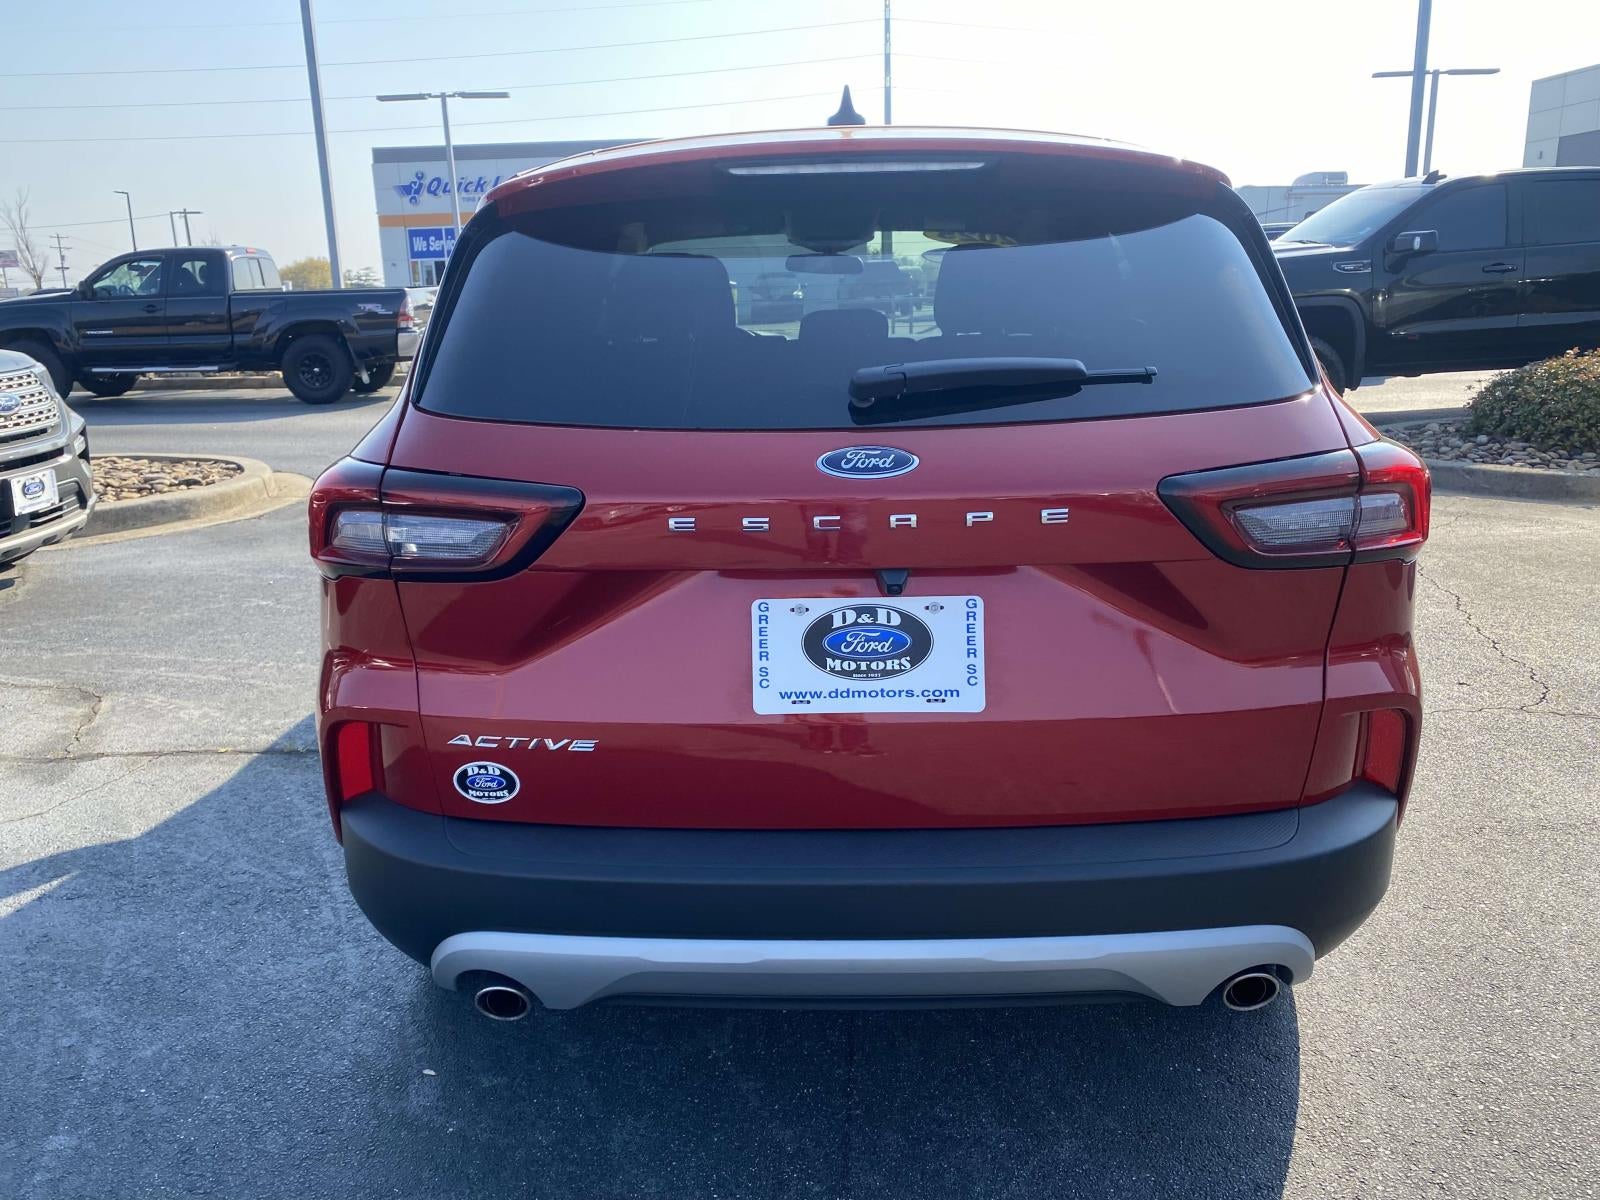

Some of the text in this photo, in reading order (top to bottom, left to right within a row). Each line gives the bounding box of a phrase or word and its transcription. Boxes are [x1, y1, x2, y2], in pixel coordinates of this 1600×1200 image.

[427, 176, 487, 196] Quick
[412, 236, 428, 252] We
[840, 450, 895, 469] Ford
[667, 508, 1070, 533] ESCAPE
[831, 607, 902, 629] D&D
[758, 602, 770, 689] GREER SC
[841, 631, 894, 654] Ford
[965, 598, 978, 687] GREER SC
[826, 656, 912, 672] MOTORS
[779, 688, 960, 700] www.ddmotors.com
[446, 734, 600, 752] ACTIVE
[466, 766, 501, 776] D&D
[474, 776, 498, 788] Ford
[468, 789, 509, 797] MOTORS
